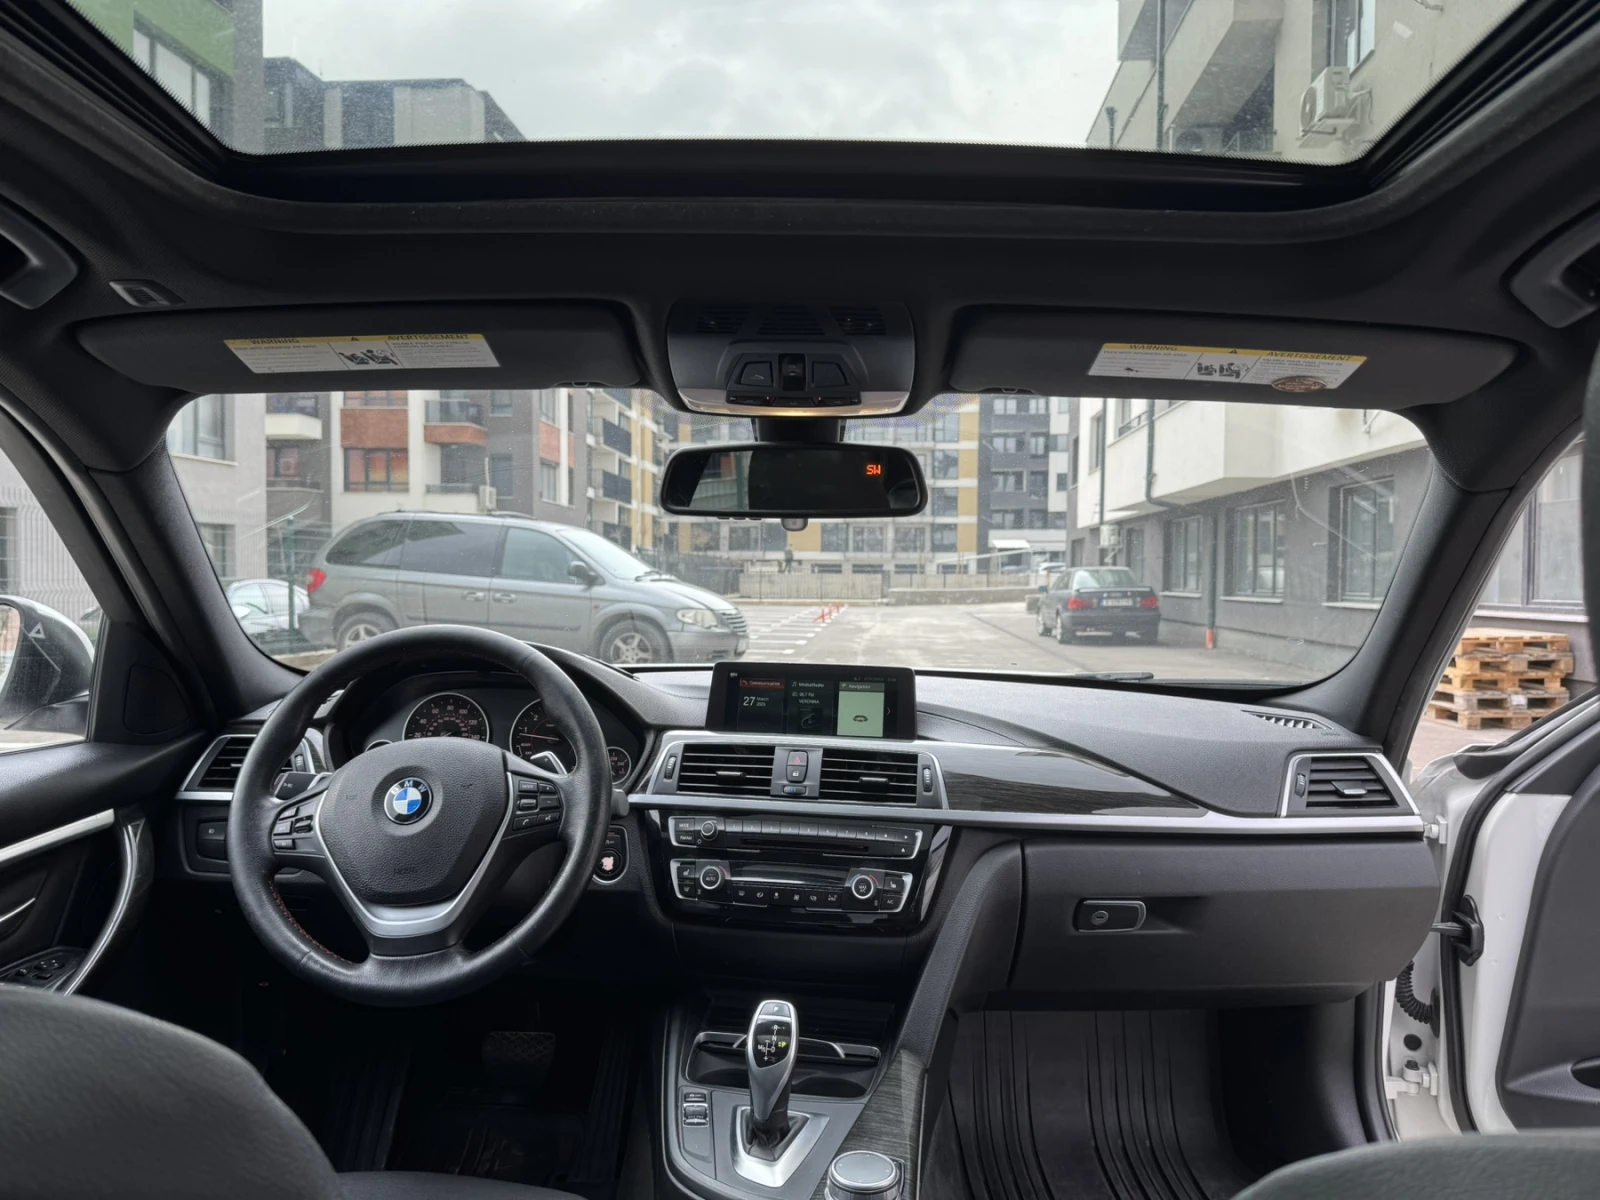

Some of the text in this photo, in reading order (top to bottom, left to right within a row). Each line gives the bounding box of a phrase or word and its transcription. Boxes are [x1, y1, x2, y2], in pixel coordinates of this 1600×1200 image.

[1267, 351, 1353, 361] AVERTISSEMENT
[866, 464, 881, 475] SW
[743, 696, 756, 706] 27
[391, 780, 428, 795] BMW
